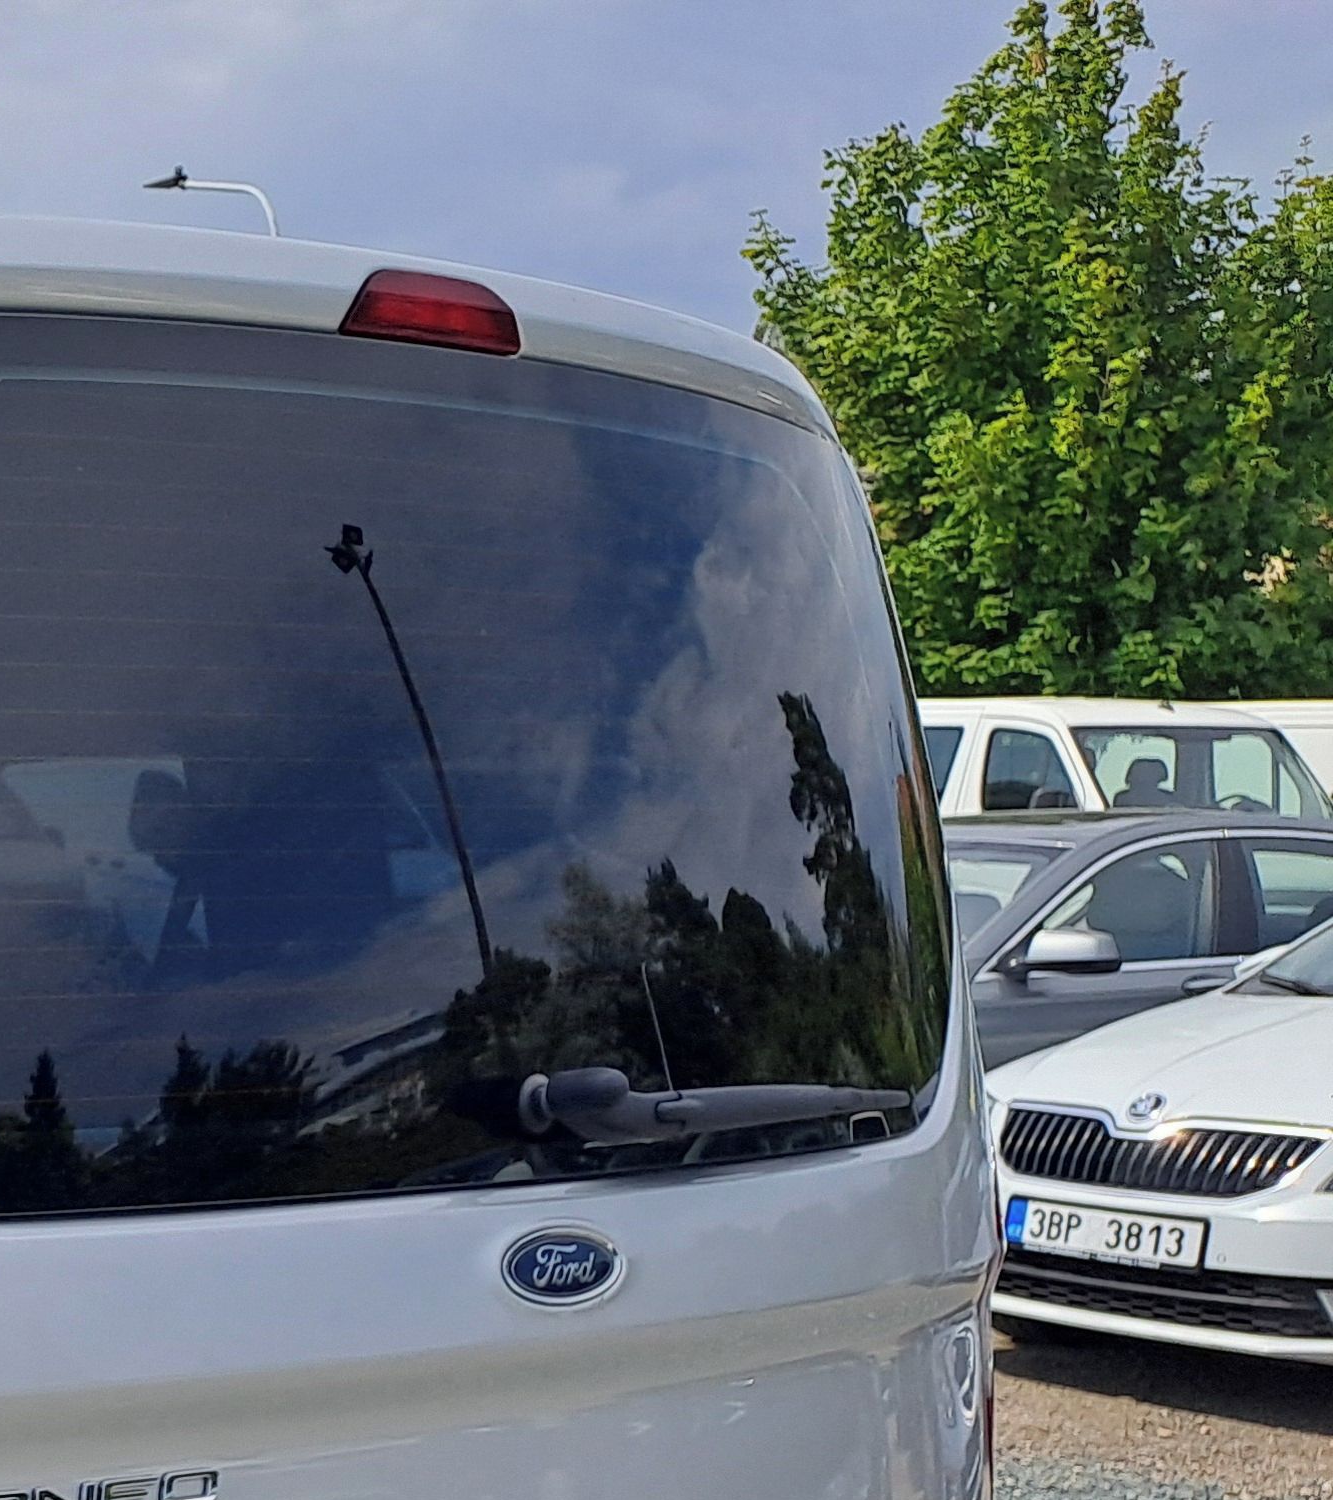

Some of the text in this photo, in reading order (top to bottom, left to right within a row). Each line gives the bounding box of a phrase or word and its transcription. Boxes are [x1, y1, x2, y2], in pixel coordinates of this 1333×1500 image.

[1030, 1208, 1185, 1258] 3BP 3813
[533, 1243, 597, 1288] Ford
